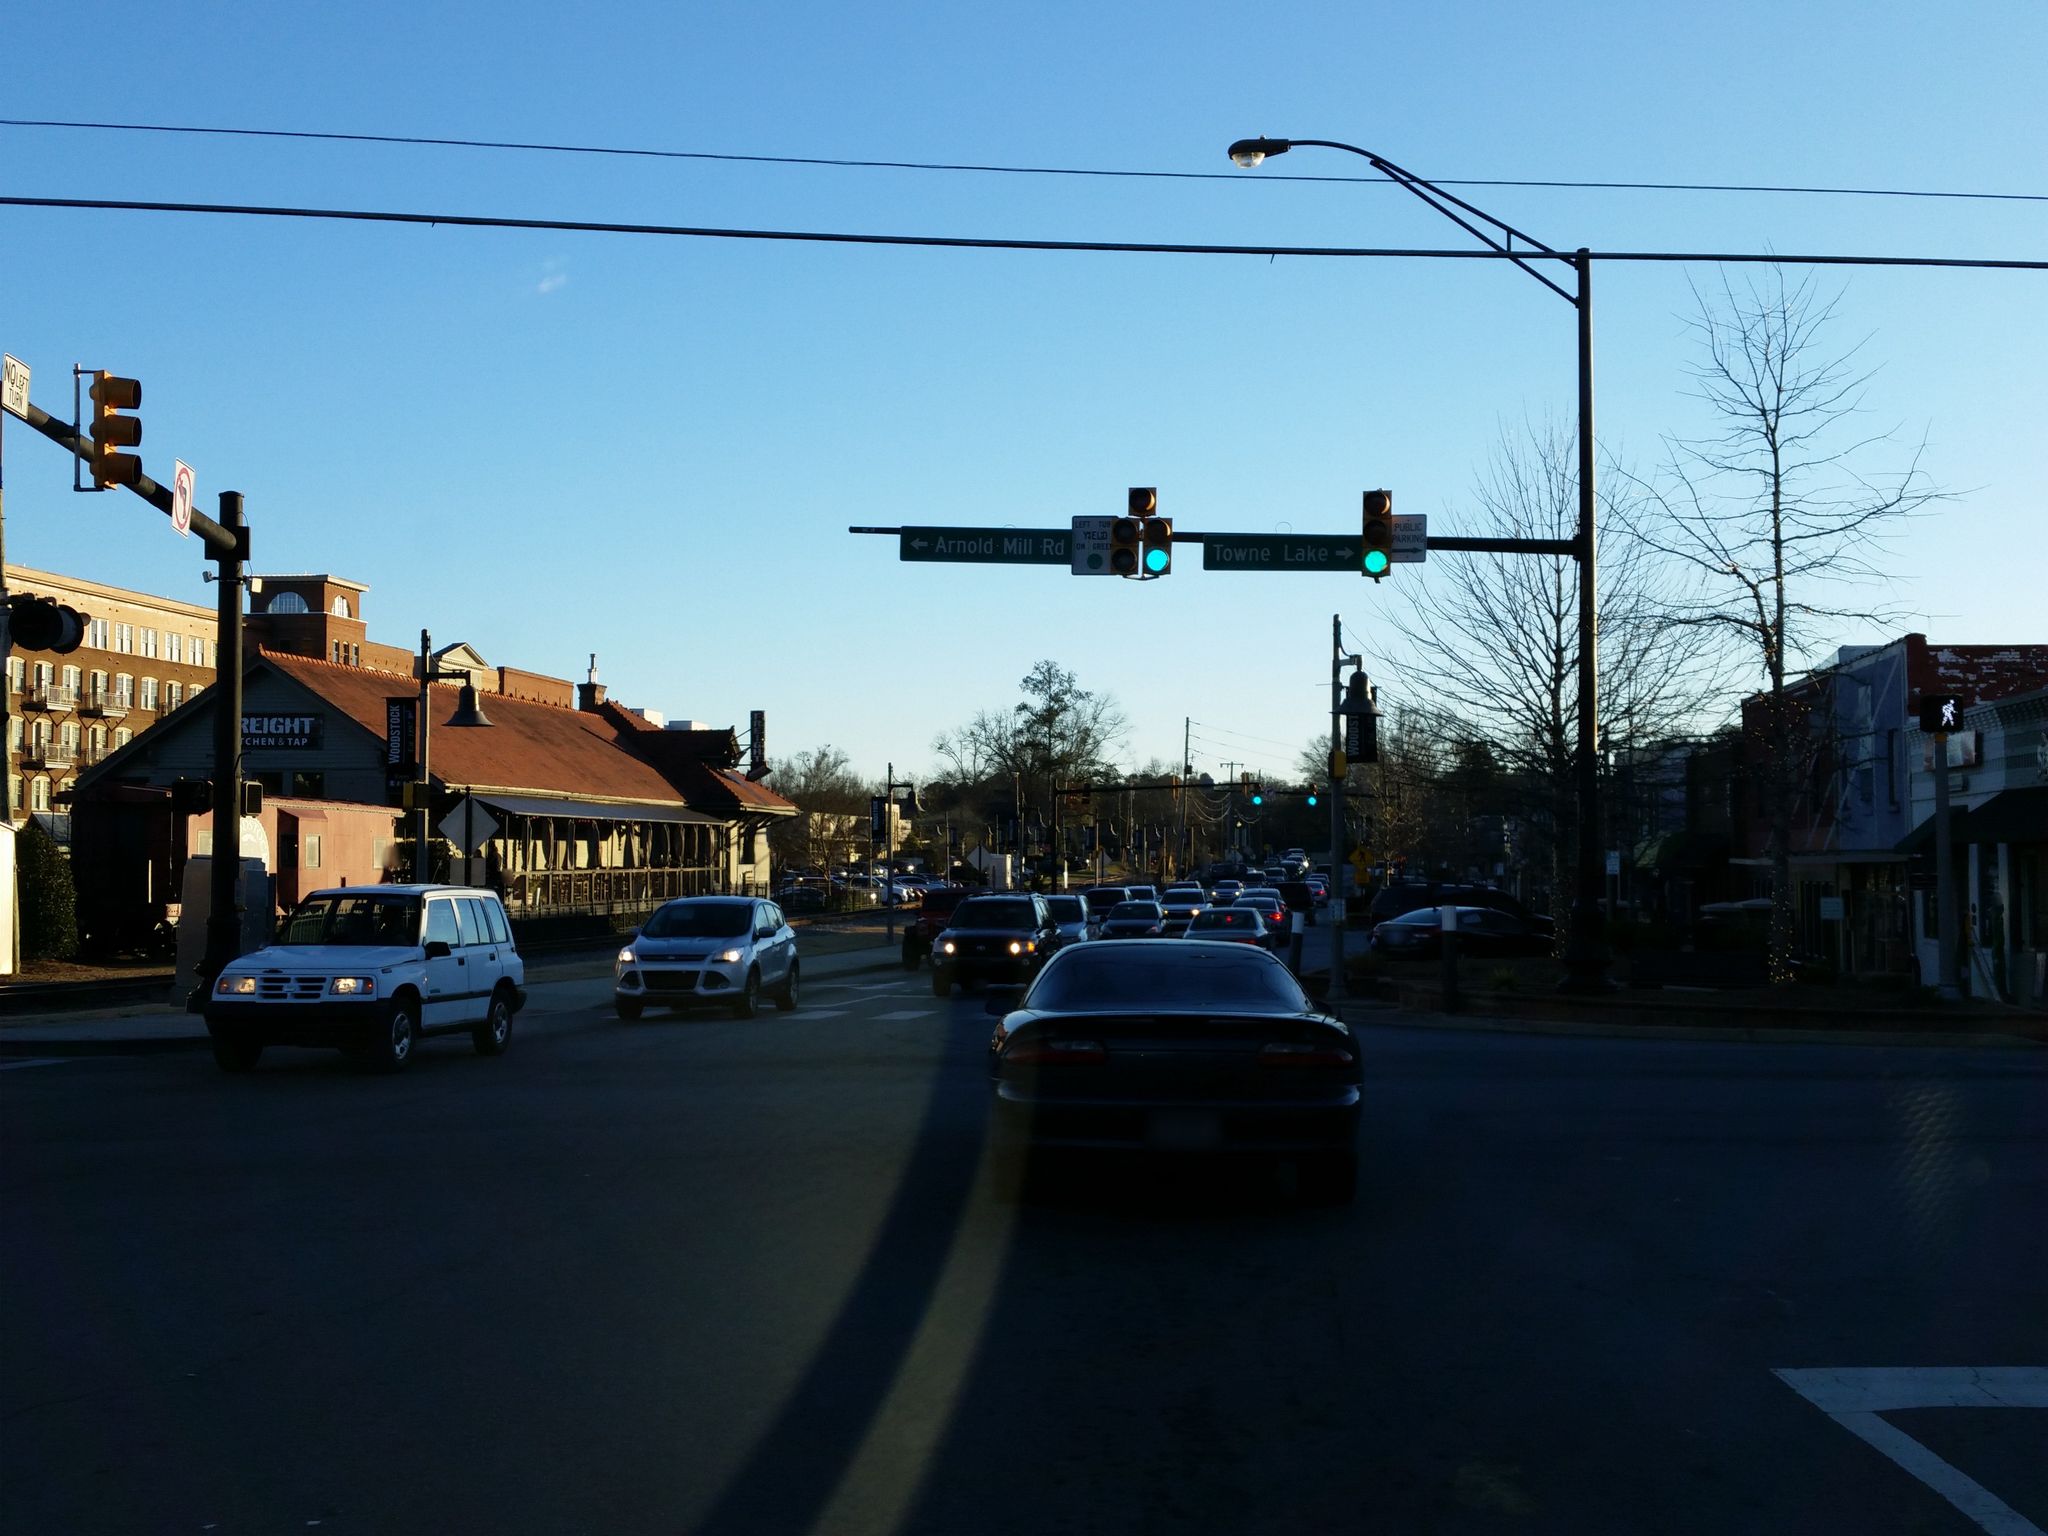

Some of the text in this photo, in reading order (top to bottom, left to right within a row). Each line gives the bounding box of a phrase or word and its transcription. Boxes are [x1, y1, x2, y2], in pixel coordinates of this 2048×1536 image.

[5, 360, 28, 393] NO LEFT
[9, 388, 23, 410] TURN
[1083, 531, 1107, 540] YIELD
[1394, 523, 1422, 532] PUBLIC
[935, 536, 1065, 556] Arnold Mill Rd
[1092, 543, 1112, 551] GREE
[1392, 534, 1425, 544] PARKING
[1212, 543, 1329, 562] Towne Lake
[241, 717, 315, 734] REIGHT
[388, 703, 402, 765] WOODSTOCK
[287, 737, 308, 746] TAP
[1347, 714, 1360, 757] WOODST
